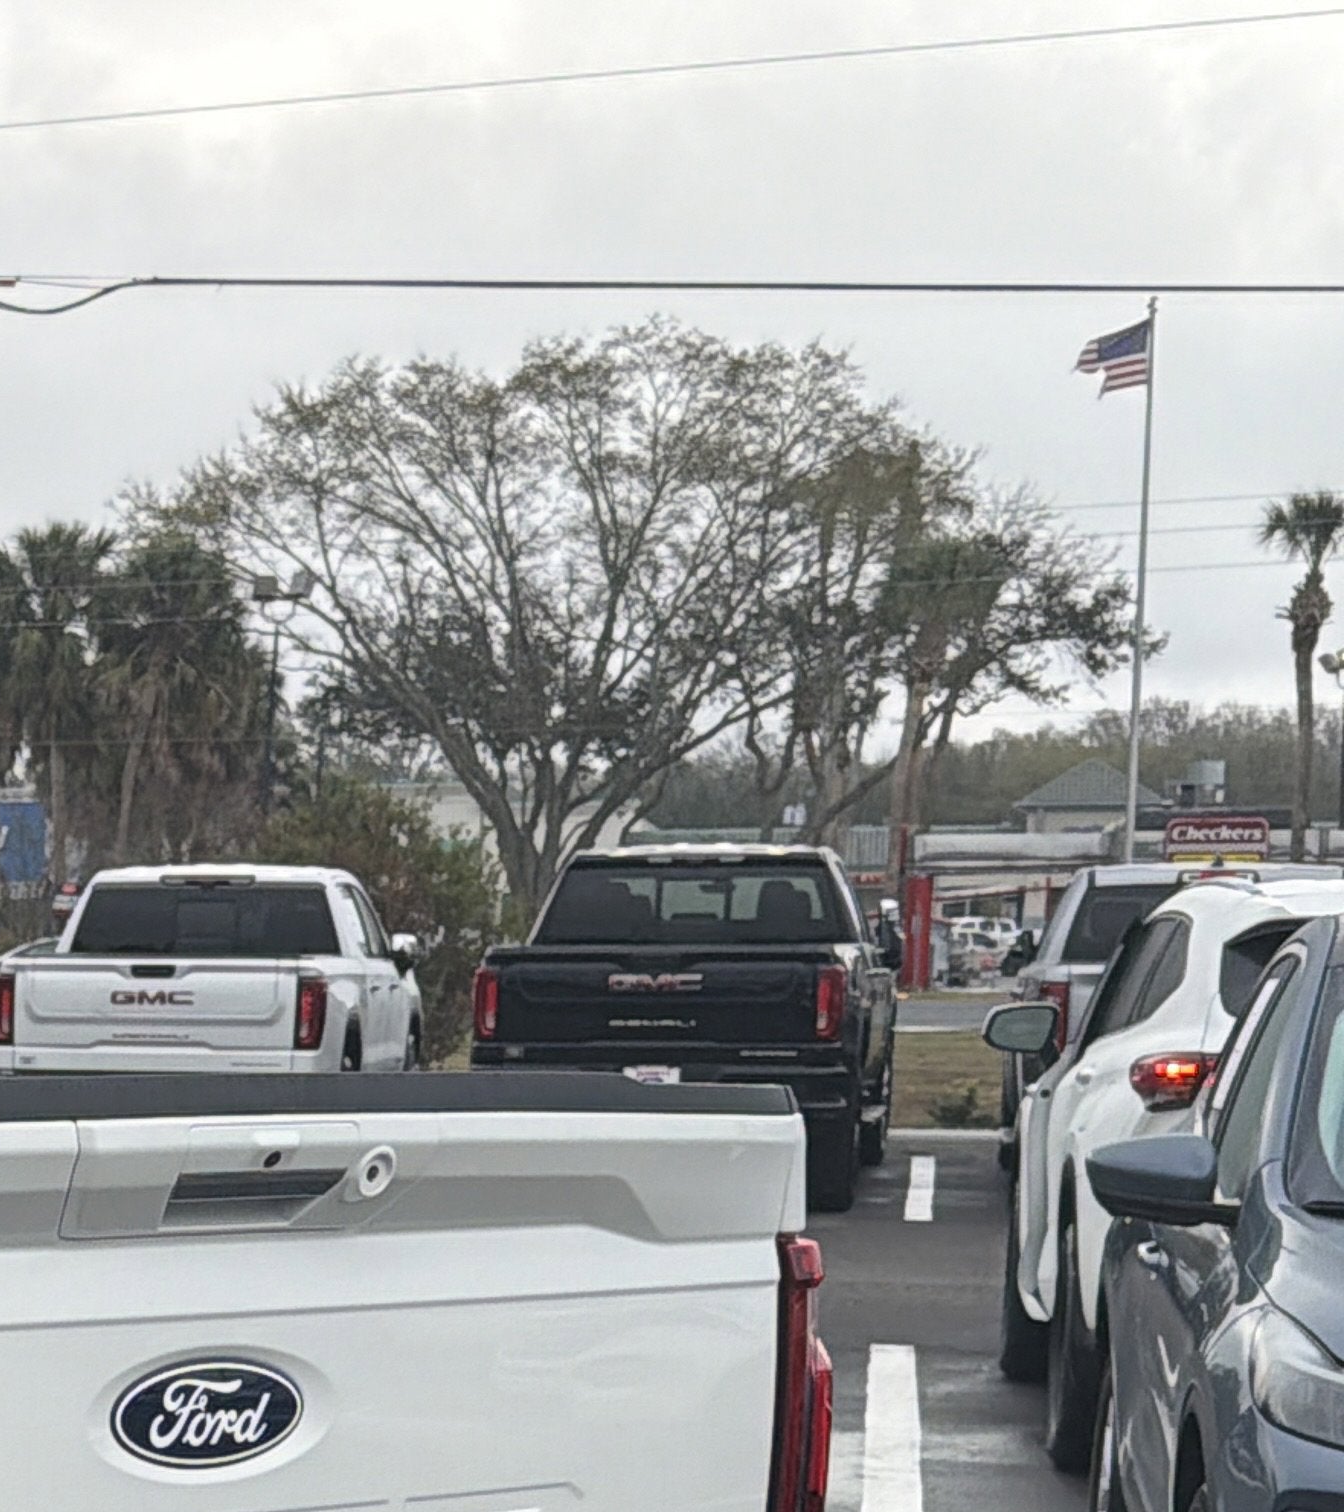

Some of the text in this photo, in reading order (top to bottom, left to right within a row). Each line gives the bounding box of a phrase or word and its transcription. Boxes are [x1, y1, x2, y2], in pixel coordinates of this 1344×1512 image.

[1171, 825, 1264, 842] Checkers
[608, 973, 703, 991] GMC
[110, 990, 195, 1005] GMC
[149, 1378, 272, 1449] Ford
